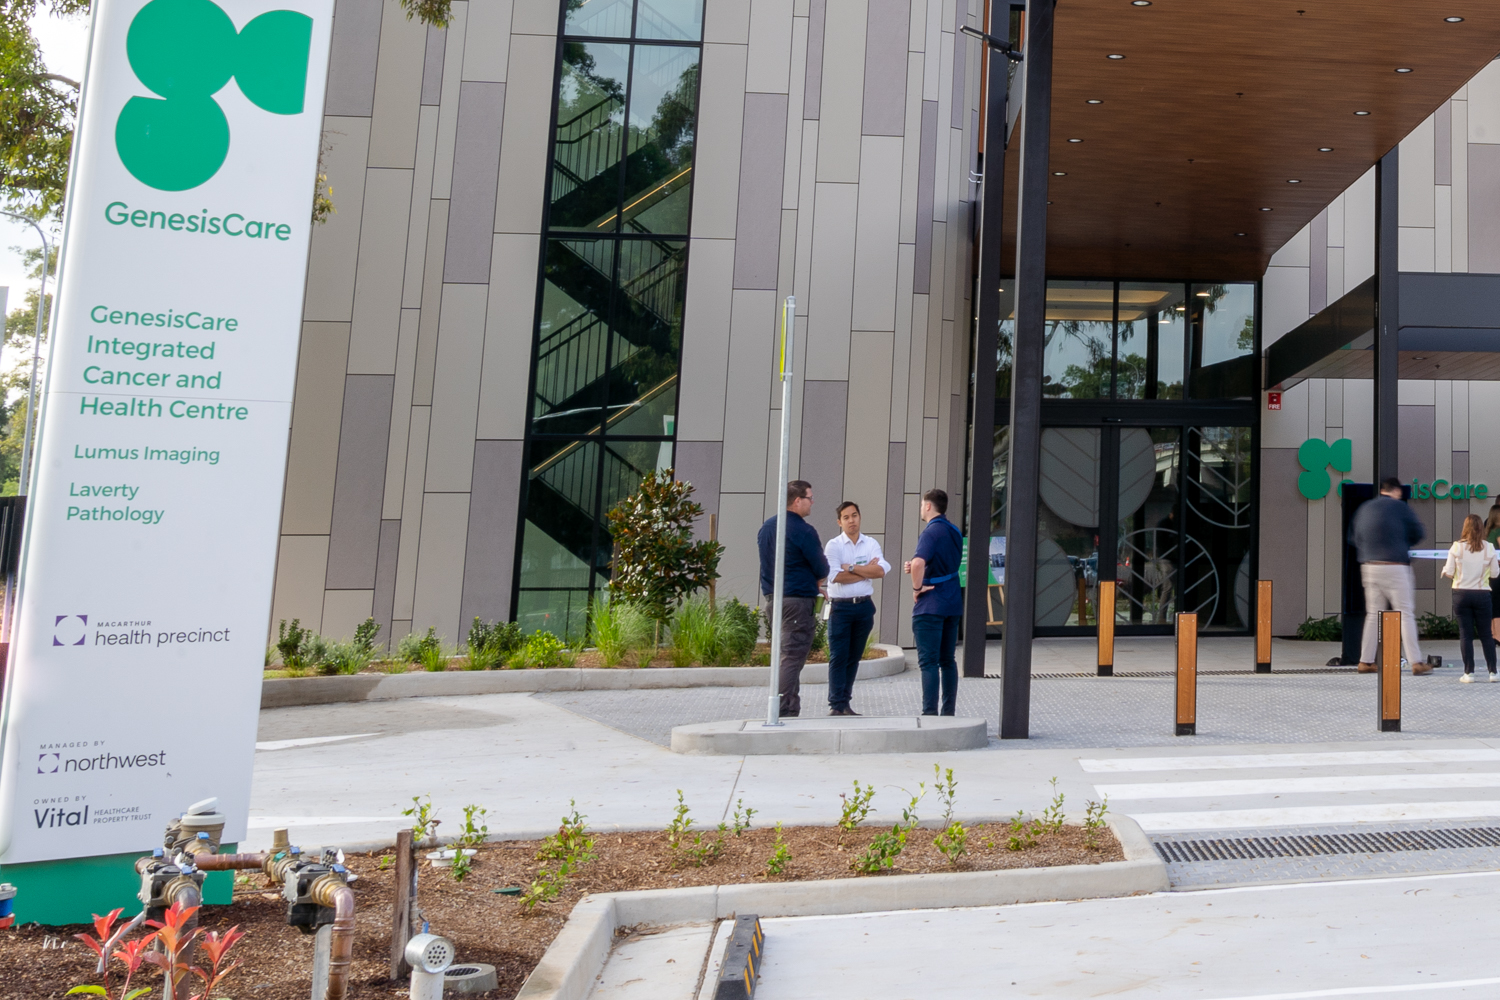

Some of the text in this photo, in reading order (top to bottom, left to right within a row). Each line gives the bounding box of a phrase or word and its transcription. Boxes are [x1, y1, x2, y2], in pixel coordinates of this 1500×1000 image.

[104, 201, 292, 241] GenesisCare
[90, 305, 239, 332] GenesisCare
[87, 335, 216, 361] Integrated
[83, 365, 222, 390] Cancer and
[79, 396, 249, 421] Health Centre
[74, 444, 220, 466] Lumus Imaging
[69, 482, 140, 501] Laverty
[66, 506, 165, 525] Pathology
[97, 620, 152, 628] MACARTHUR
[95, 627, 231, 648] health precinct
[40, 741, 89, 750] MANAGED
[64, 750, 167, 773] northwest
[33, 796, 70, 805] OWNED
[94, 806, 140, 816] HEALTHCARE
[34, 804, 89, 829] Vital
[93, 813, 152, 825] PROPERTY TRUST
